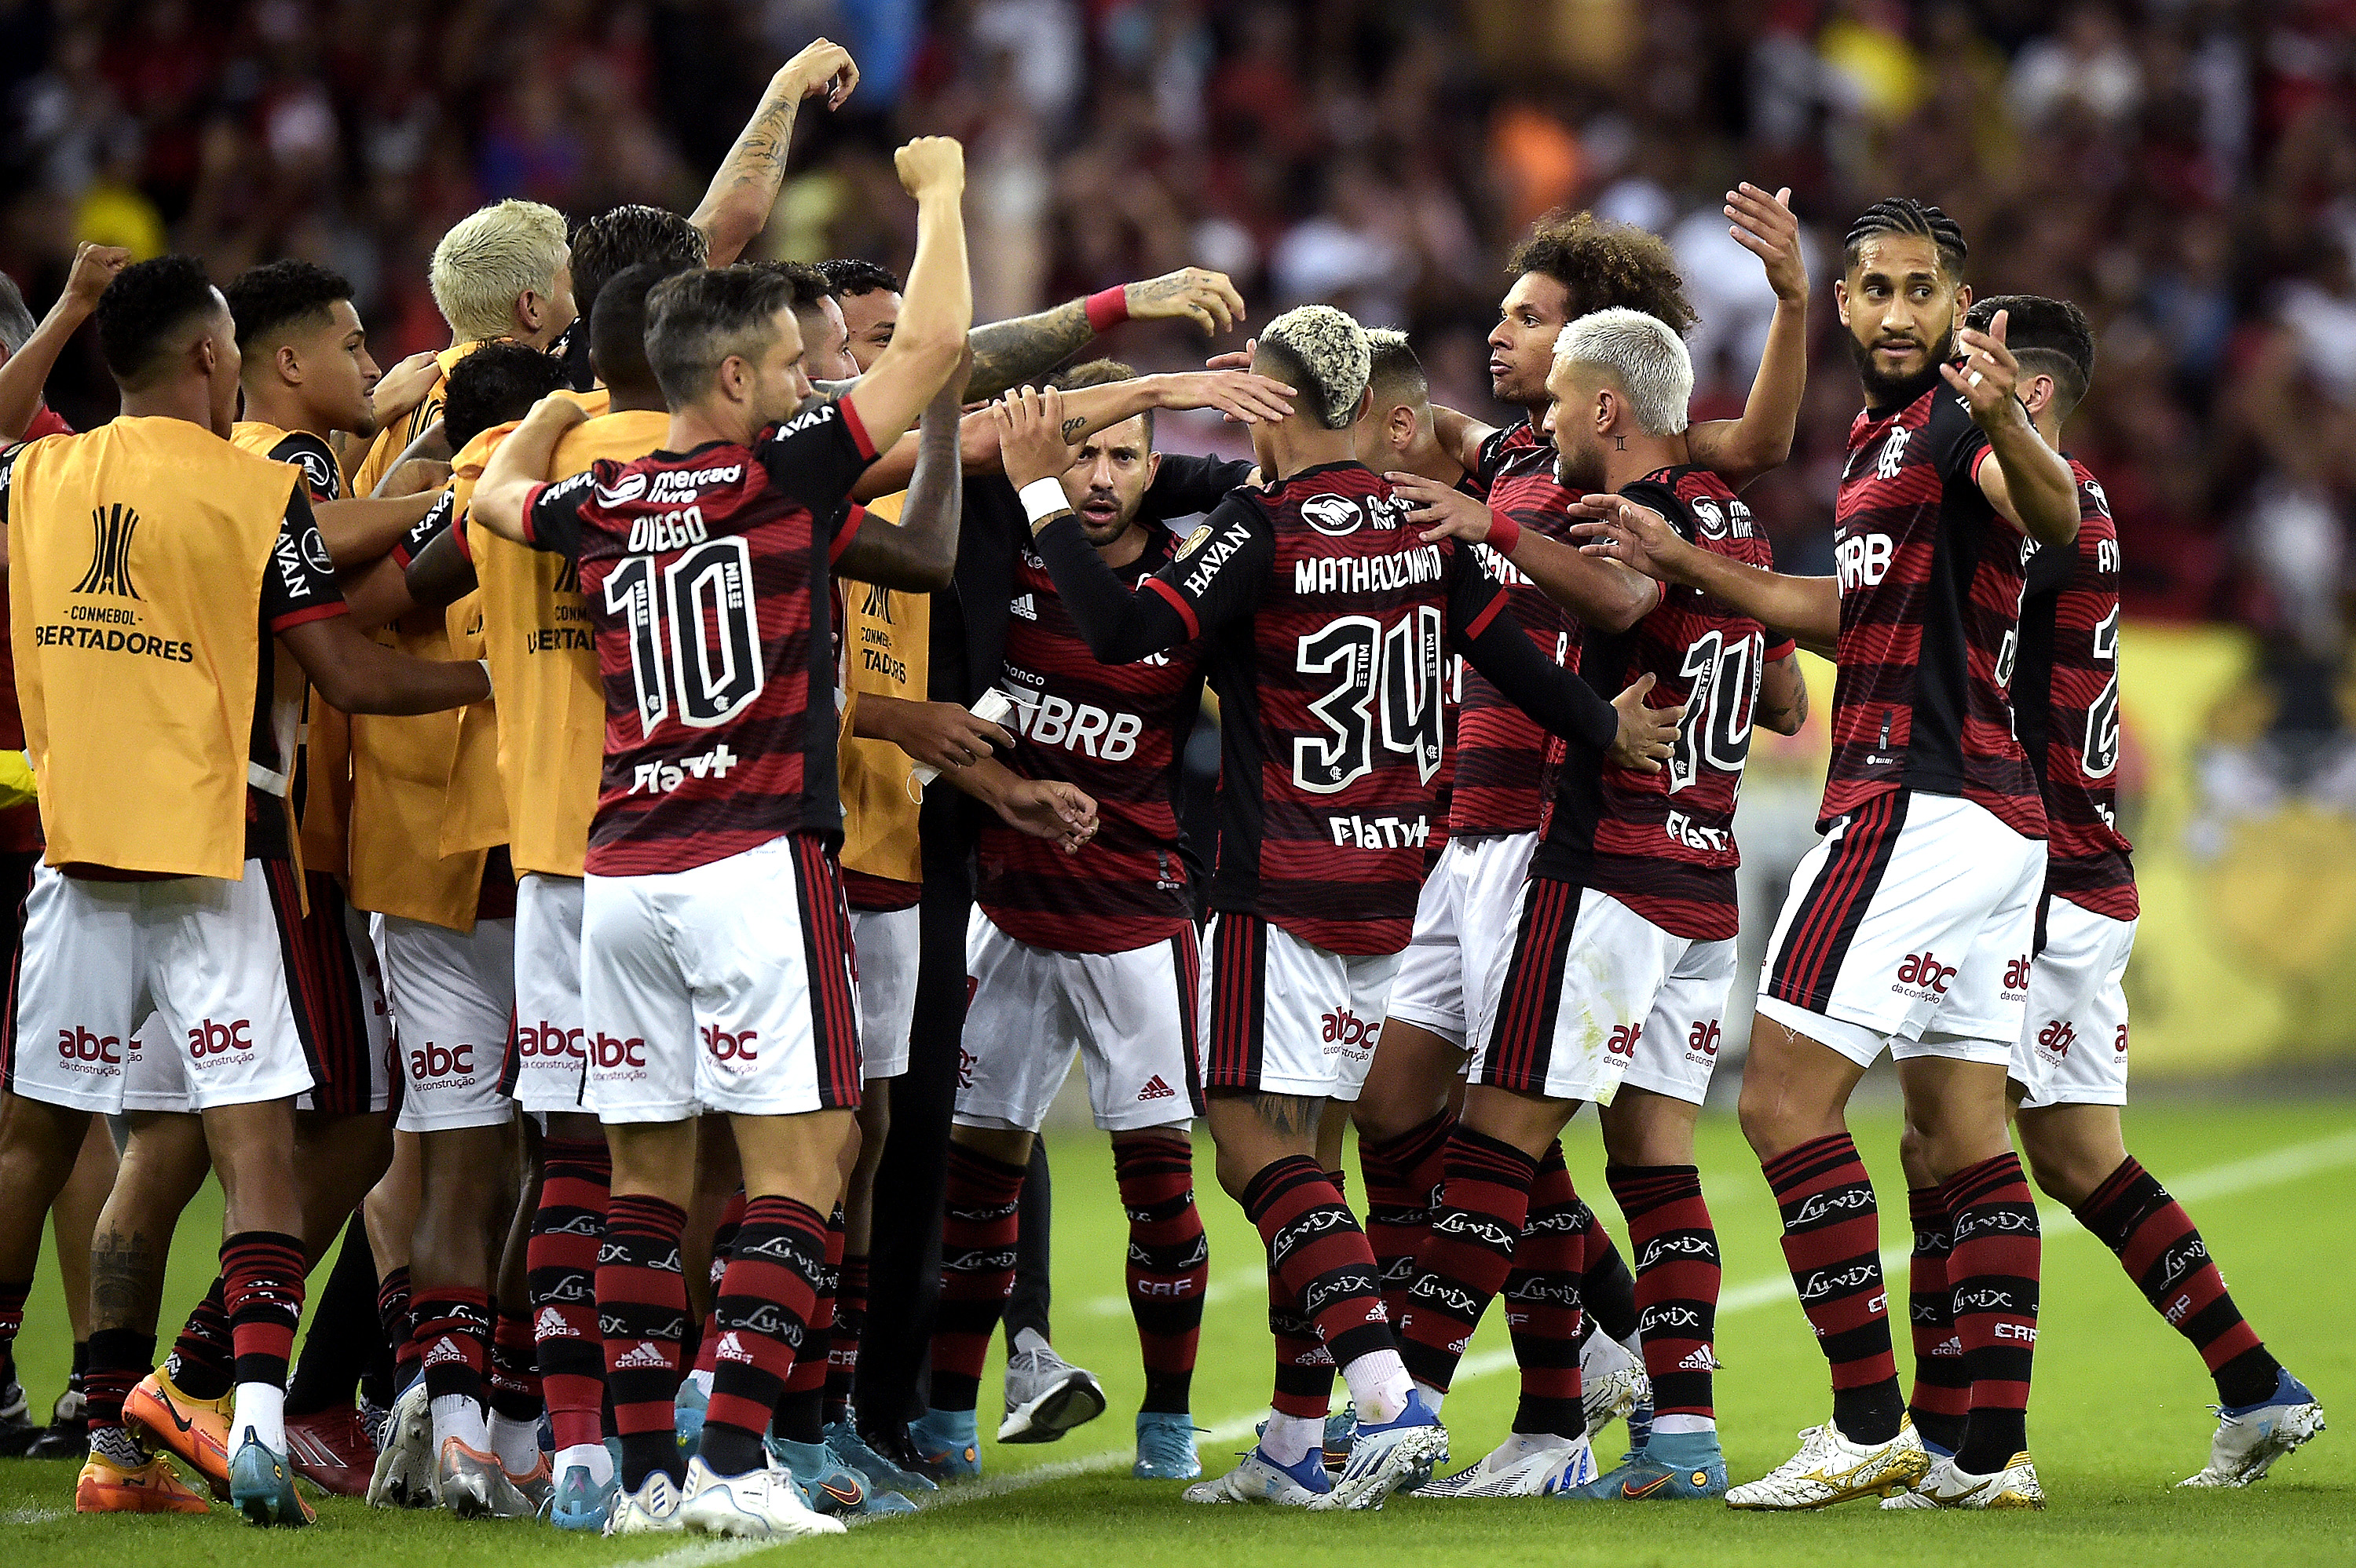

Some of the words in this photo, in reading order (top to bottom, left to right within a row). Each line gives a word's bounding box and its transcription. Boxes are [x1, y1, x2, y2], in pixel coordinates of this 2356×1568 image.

[627, 506, 708, 552] DIEGO
[1183, 521, 1252, 598] HAVAN
[603, 535, 765, 740] 10
[1293, 605, 1443, 795] 34
[1031, 694, 1143, 762] BRB
[1897, 952, 1957, 994] abc
[2003, 954, 2031, 990] ab
[58, 1025, 121, 1064] abc
[188, 1018, 252, 1059] abc
[1321, 1006, 1381, 1050] abc
[1688, 1019, 1721, 1056] ab
[71, 1062, 121, 1076] construção
[203, 1052, 255, 1069] construção
[411, 1041, 474, 1080] abc
[423, 1076, 475, 1091] construção
[425, 1351, 468, 1368] adidas
